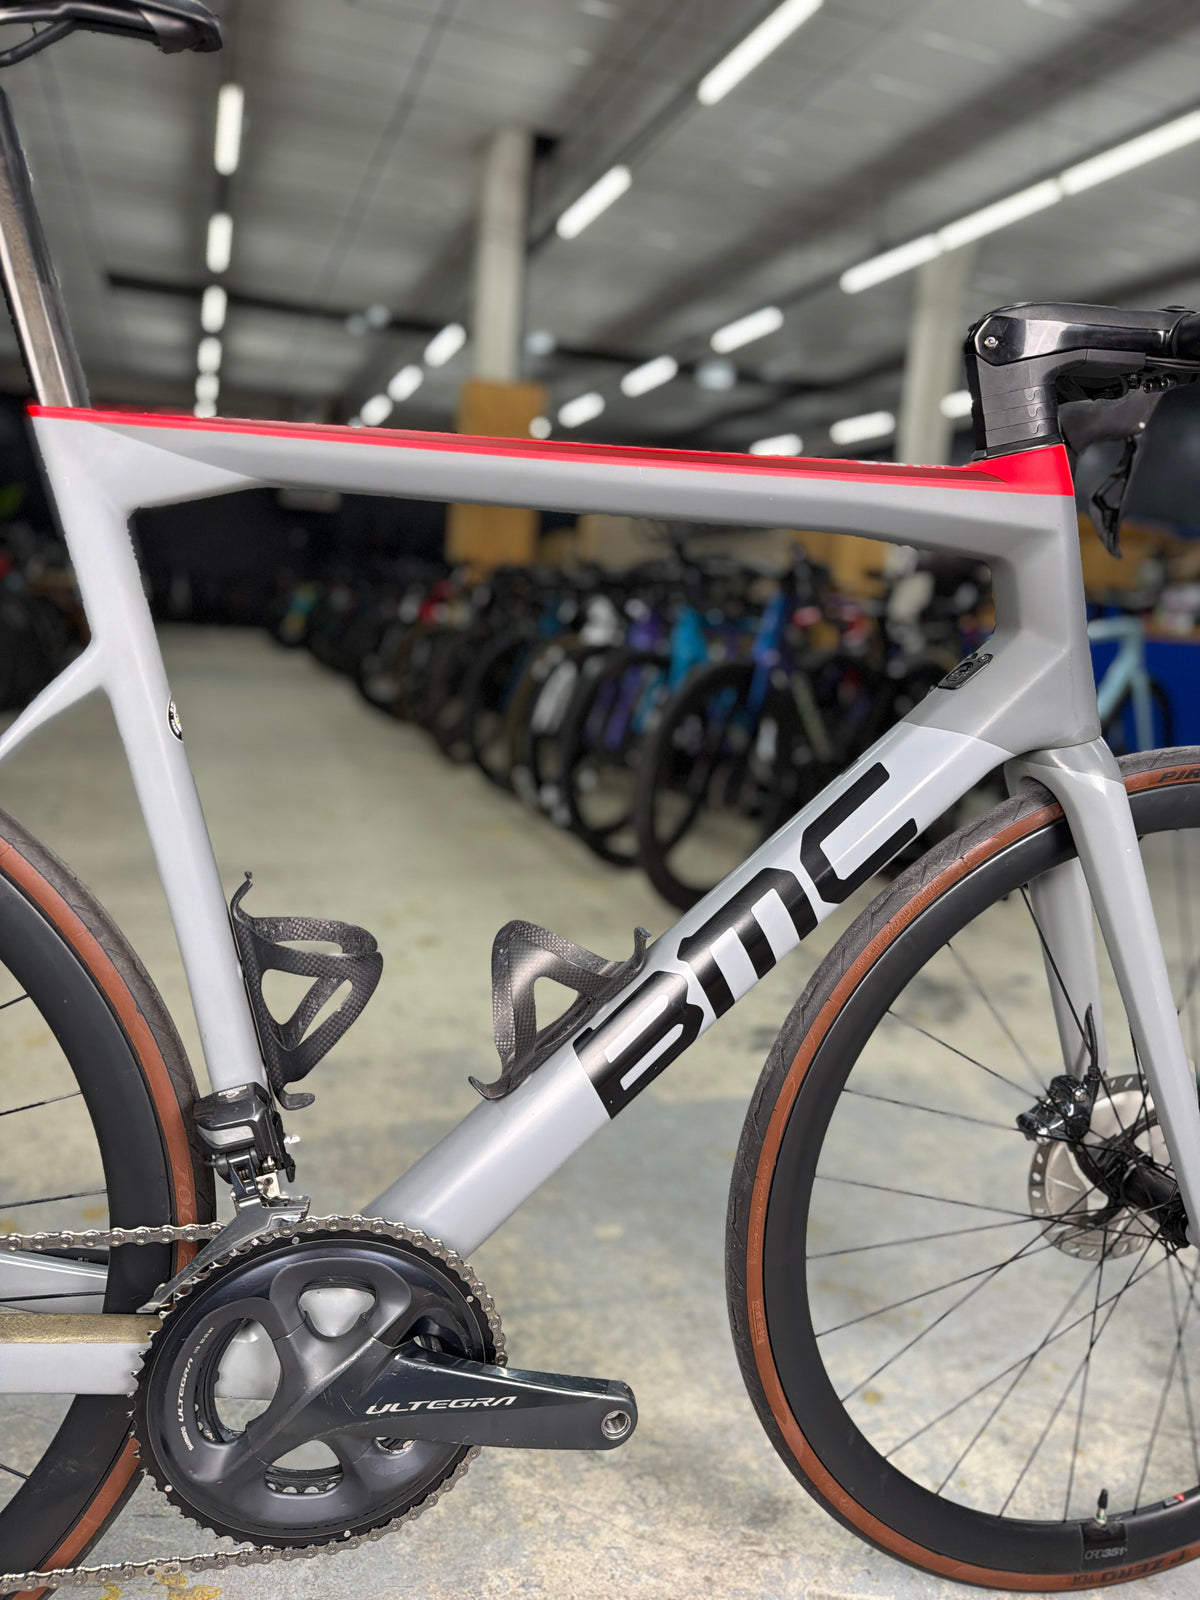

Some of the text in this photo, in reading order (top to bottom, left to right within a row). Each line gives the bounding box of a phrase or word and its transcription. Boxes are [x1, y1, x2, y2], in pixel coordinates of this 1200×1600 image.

[572, 762, 918, 1119] BMC
[178, 1357, 194, 1422] ULTEGRA
[365, 1396, 518, 1415] ULTEGRA
